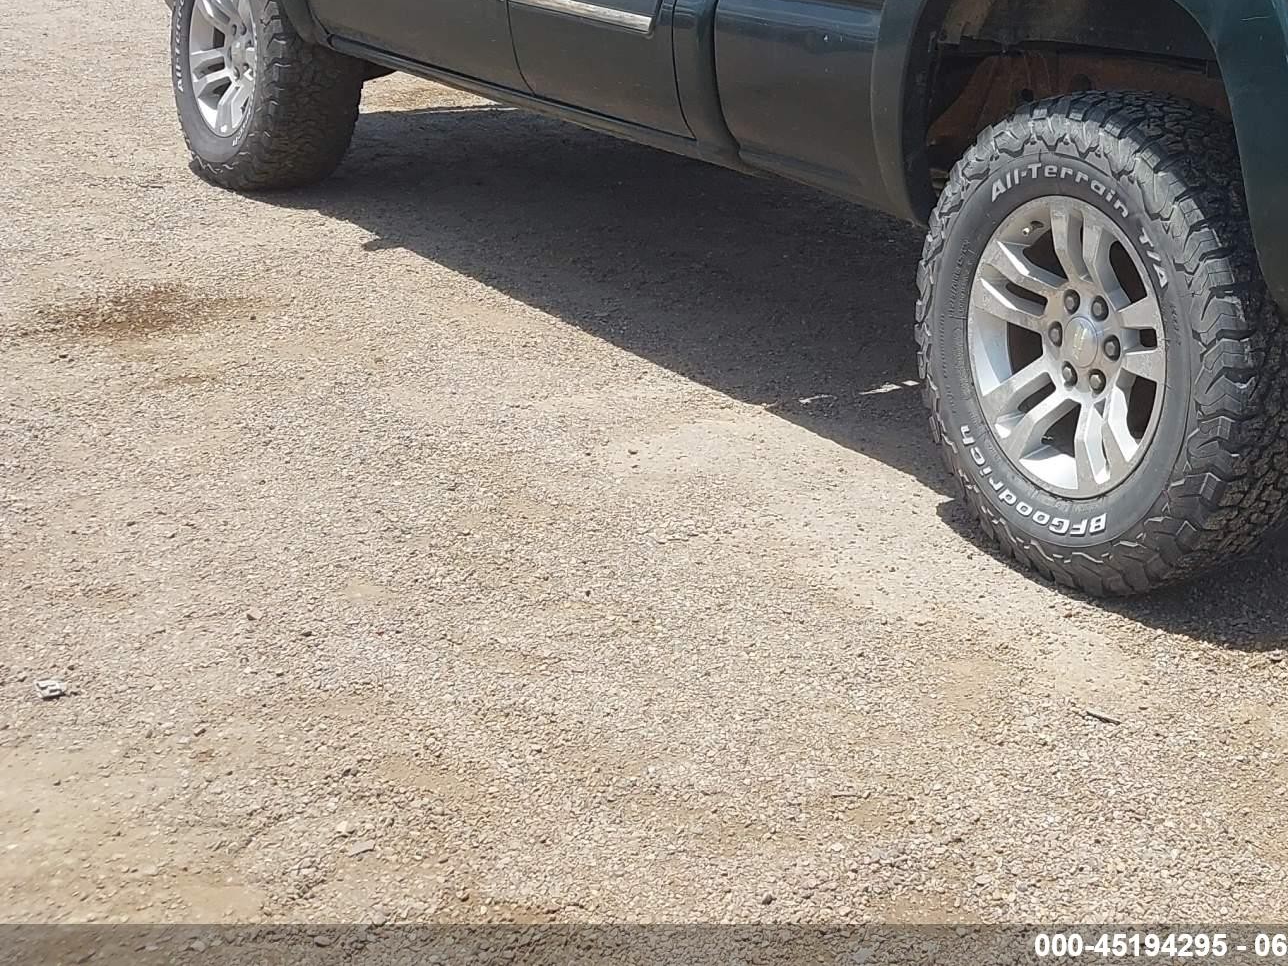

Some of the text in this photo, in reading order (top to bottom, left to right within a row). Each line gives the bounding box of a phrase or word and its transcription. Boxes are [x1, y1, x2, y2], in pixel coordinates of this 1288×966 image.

[990, 161, 1169, 289] All-Terrain T/A
[960, 425, 1107, 536] BFGoodrich
